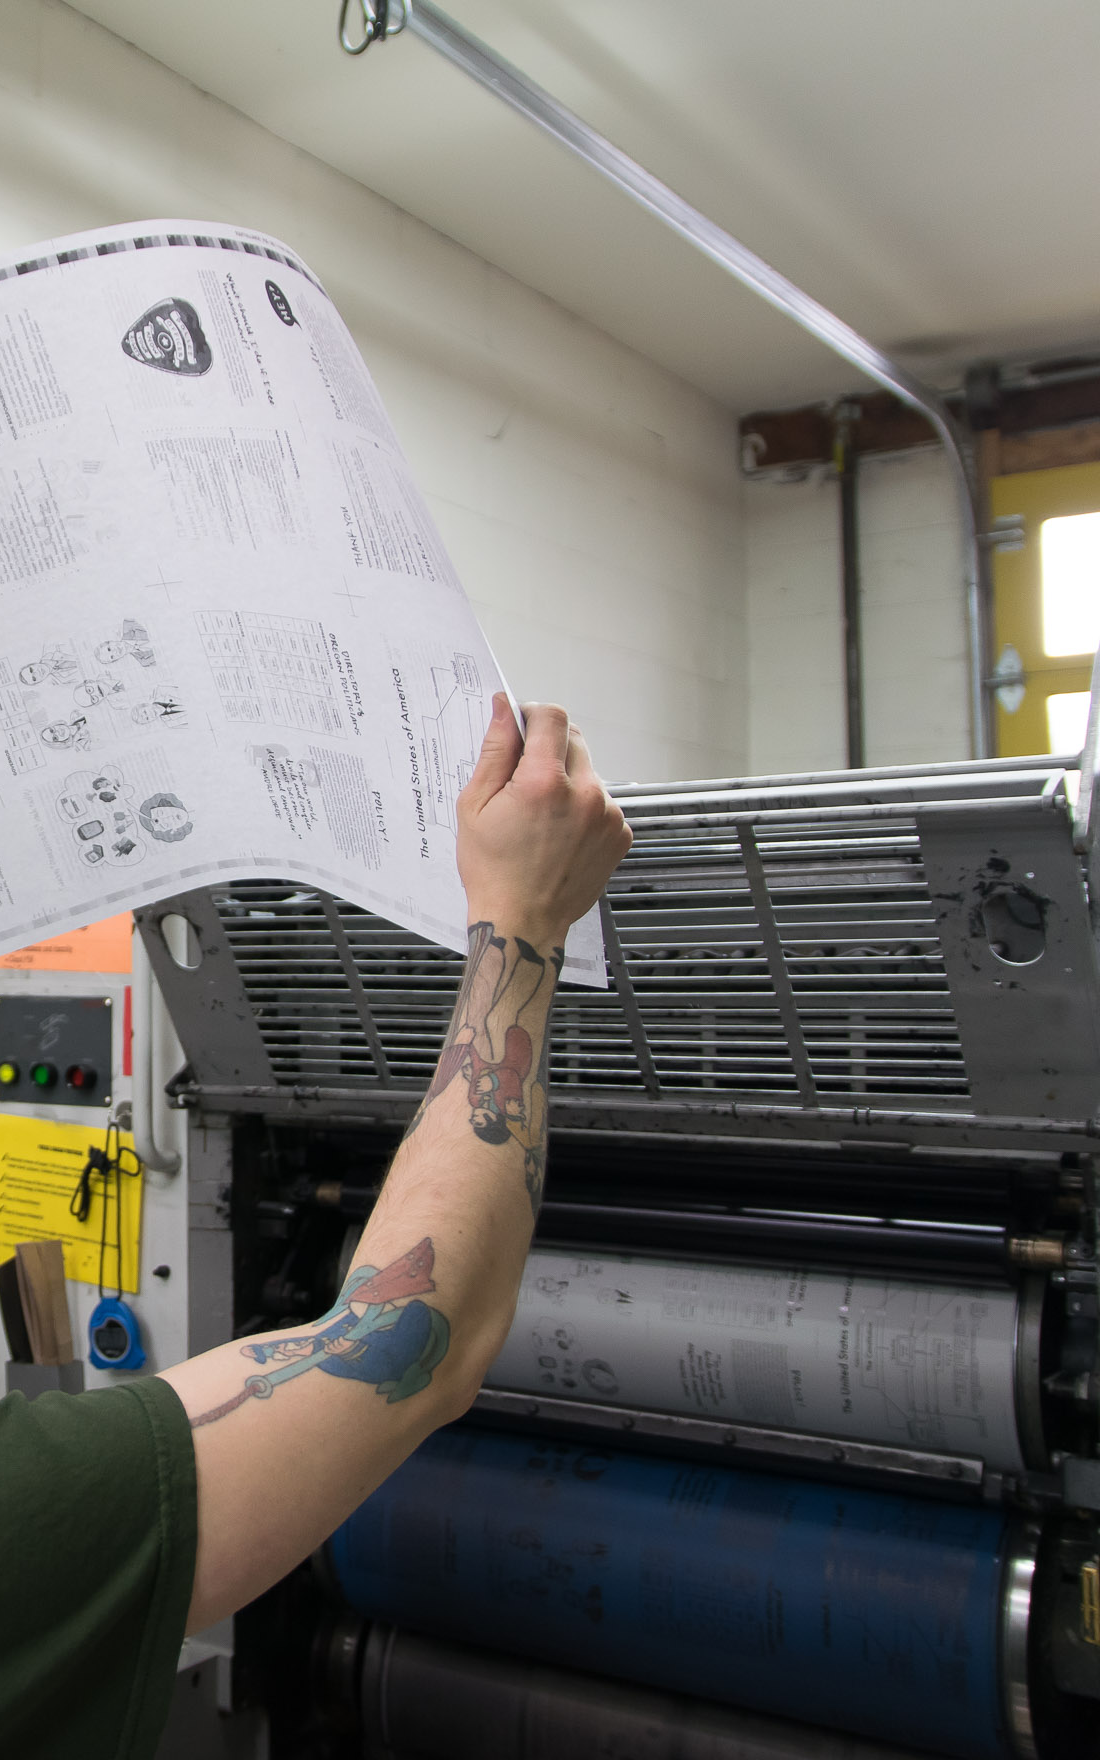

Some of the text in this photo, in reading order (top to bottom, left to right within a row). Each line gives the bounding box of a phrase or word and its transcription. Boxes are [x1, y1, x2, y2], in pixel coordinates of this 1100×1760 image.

[222, 281, 251, 351] harassment?
[269, 285, 291, 322] HEY!
[225, 272, 240, 299] What
[237, 302, 254, 336] should
[254, 350, 262, 364] do
[266, 389, 275, 405] see
[340, 506, 364, 568] THANK YOU
[328, 632, 362, 736] OREGON POLITICIANS
[341, 650, 363, 707] DIRECTORY
[391, 668, 430, 859] The United States of America
[431, 737, 442, 787] Constitution
[371, 790, 390, 843] POLICY!
[839, 1329, 849, 1360] States
